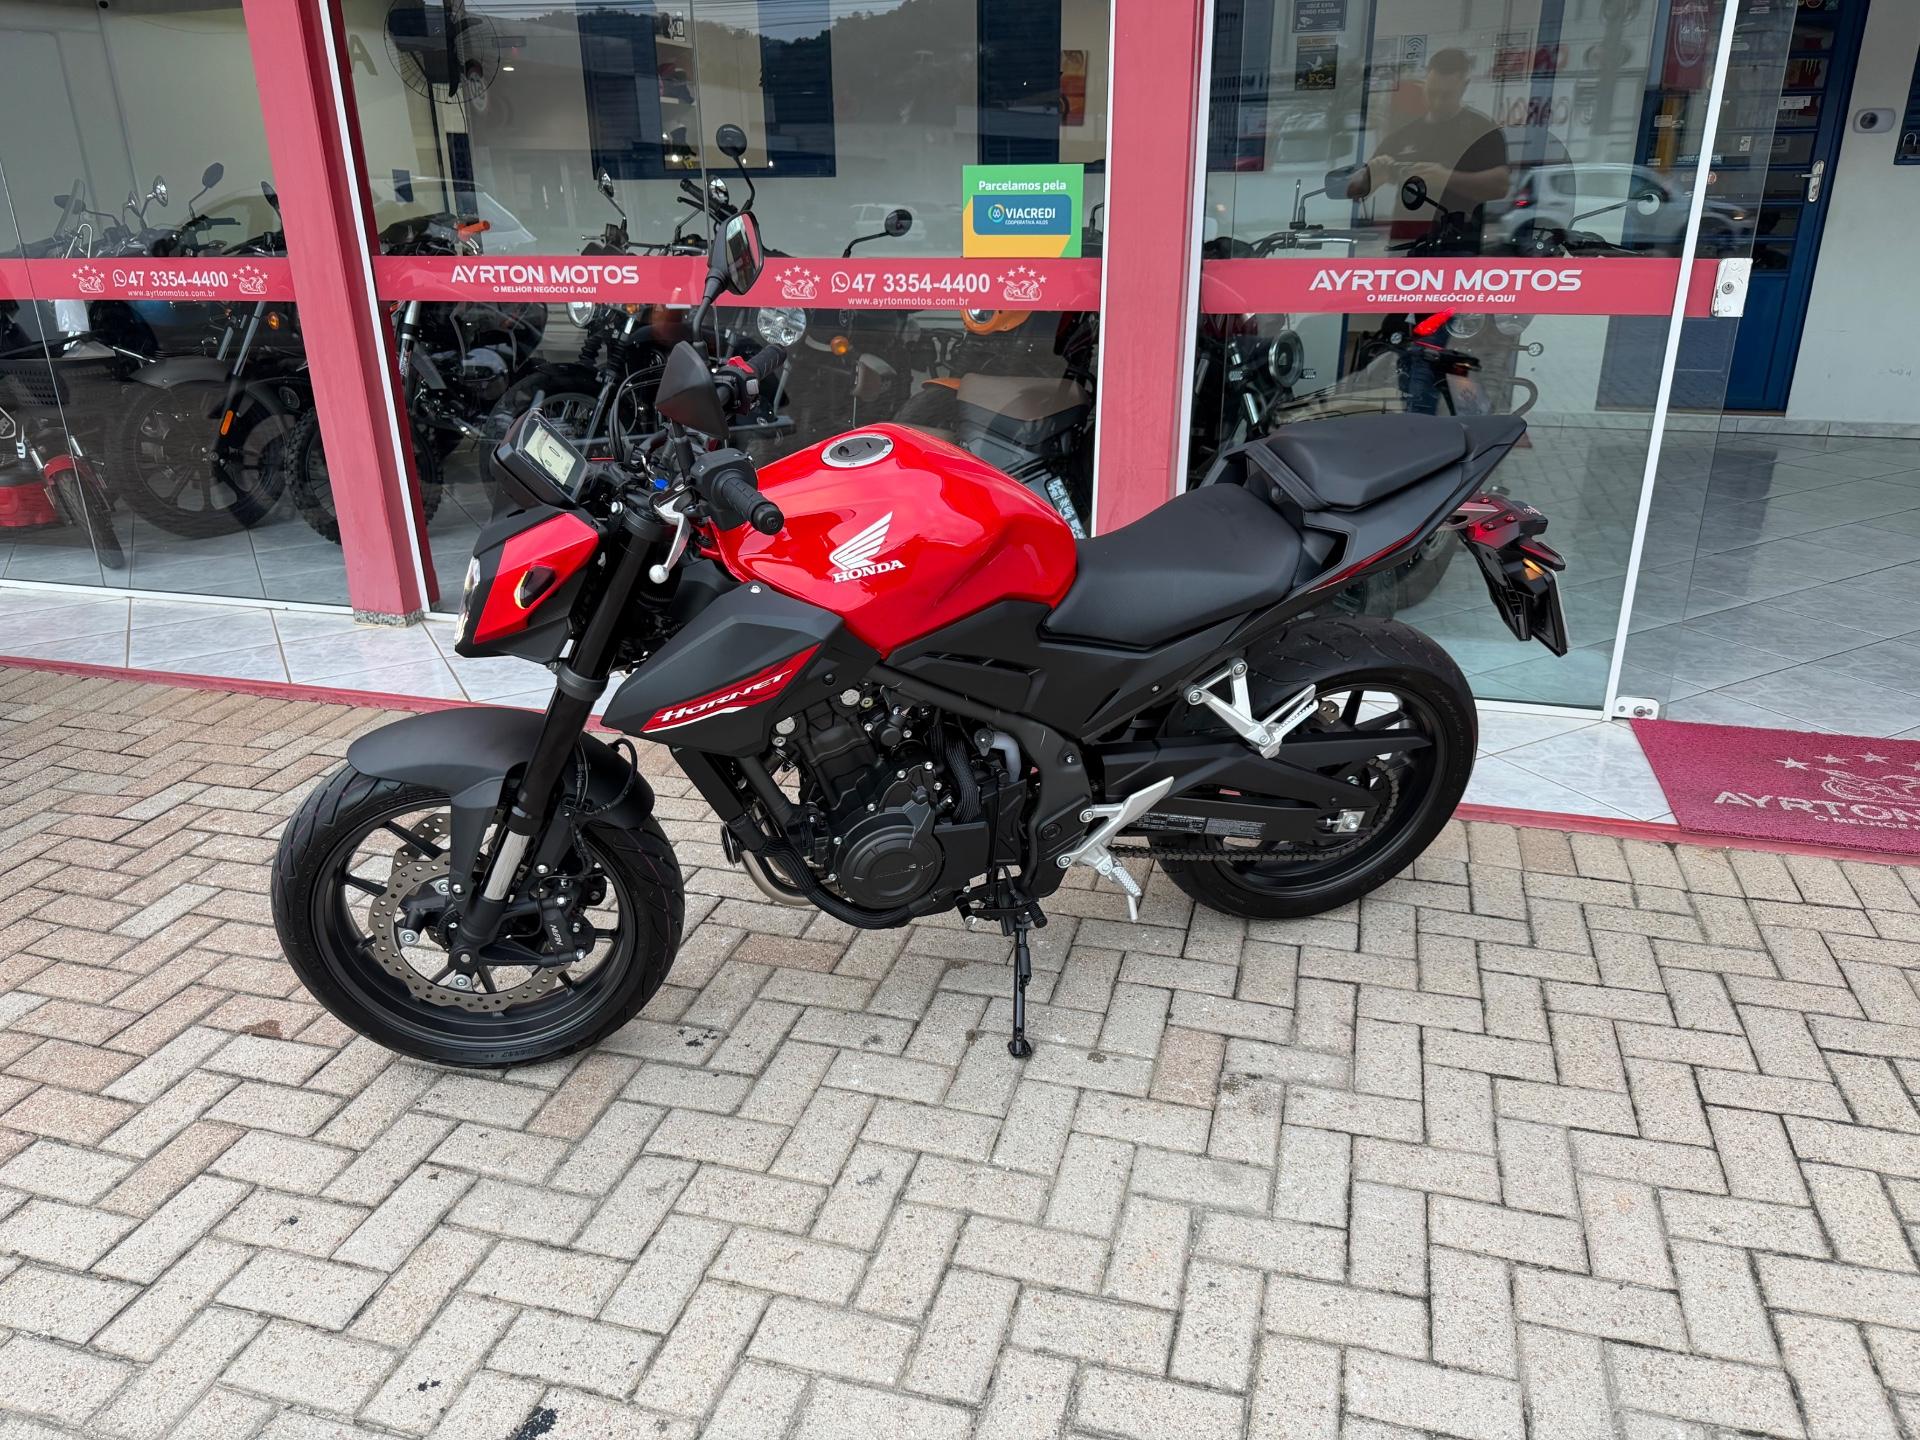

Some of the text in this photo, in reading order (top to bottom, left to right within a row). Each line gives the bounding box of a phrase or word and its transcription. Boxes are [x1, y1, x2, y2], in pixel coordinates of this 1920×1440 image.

[978, 180, 1067, 192] Parcelamos pela
[1005, 207, 1056, 219] VIACREDI
[128, 270, 228, 288] 47 3354-4400
[451, 265, 640, 285] AYRTON MOTOS
[1308, 269, 1583, 291] AYRTON MOTOS
[493, 285, 597, 294] O MELHOR NEGÓCIO É AQUI
[852, 273, 990, 293] 47 3354-4400
[128, 289, 216, 298] www.ayrtonmotos.com.br
[1366, 293, 1516, 303] O MELHOR NEGÓCIO É AQUI
[847, 296, 969, 306] www.ayrtonmotos.com.br
[832, 560, 906, 584] HONDA
[1832, 816, 1909, 830] MELHOR
